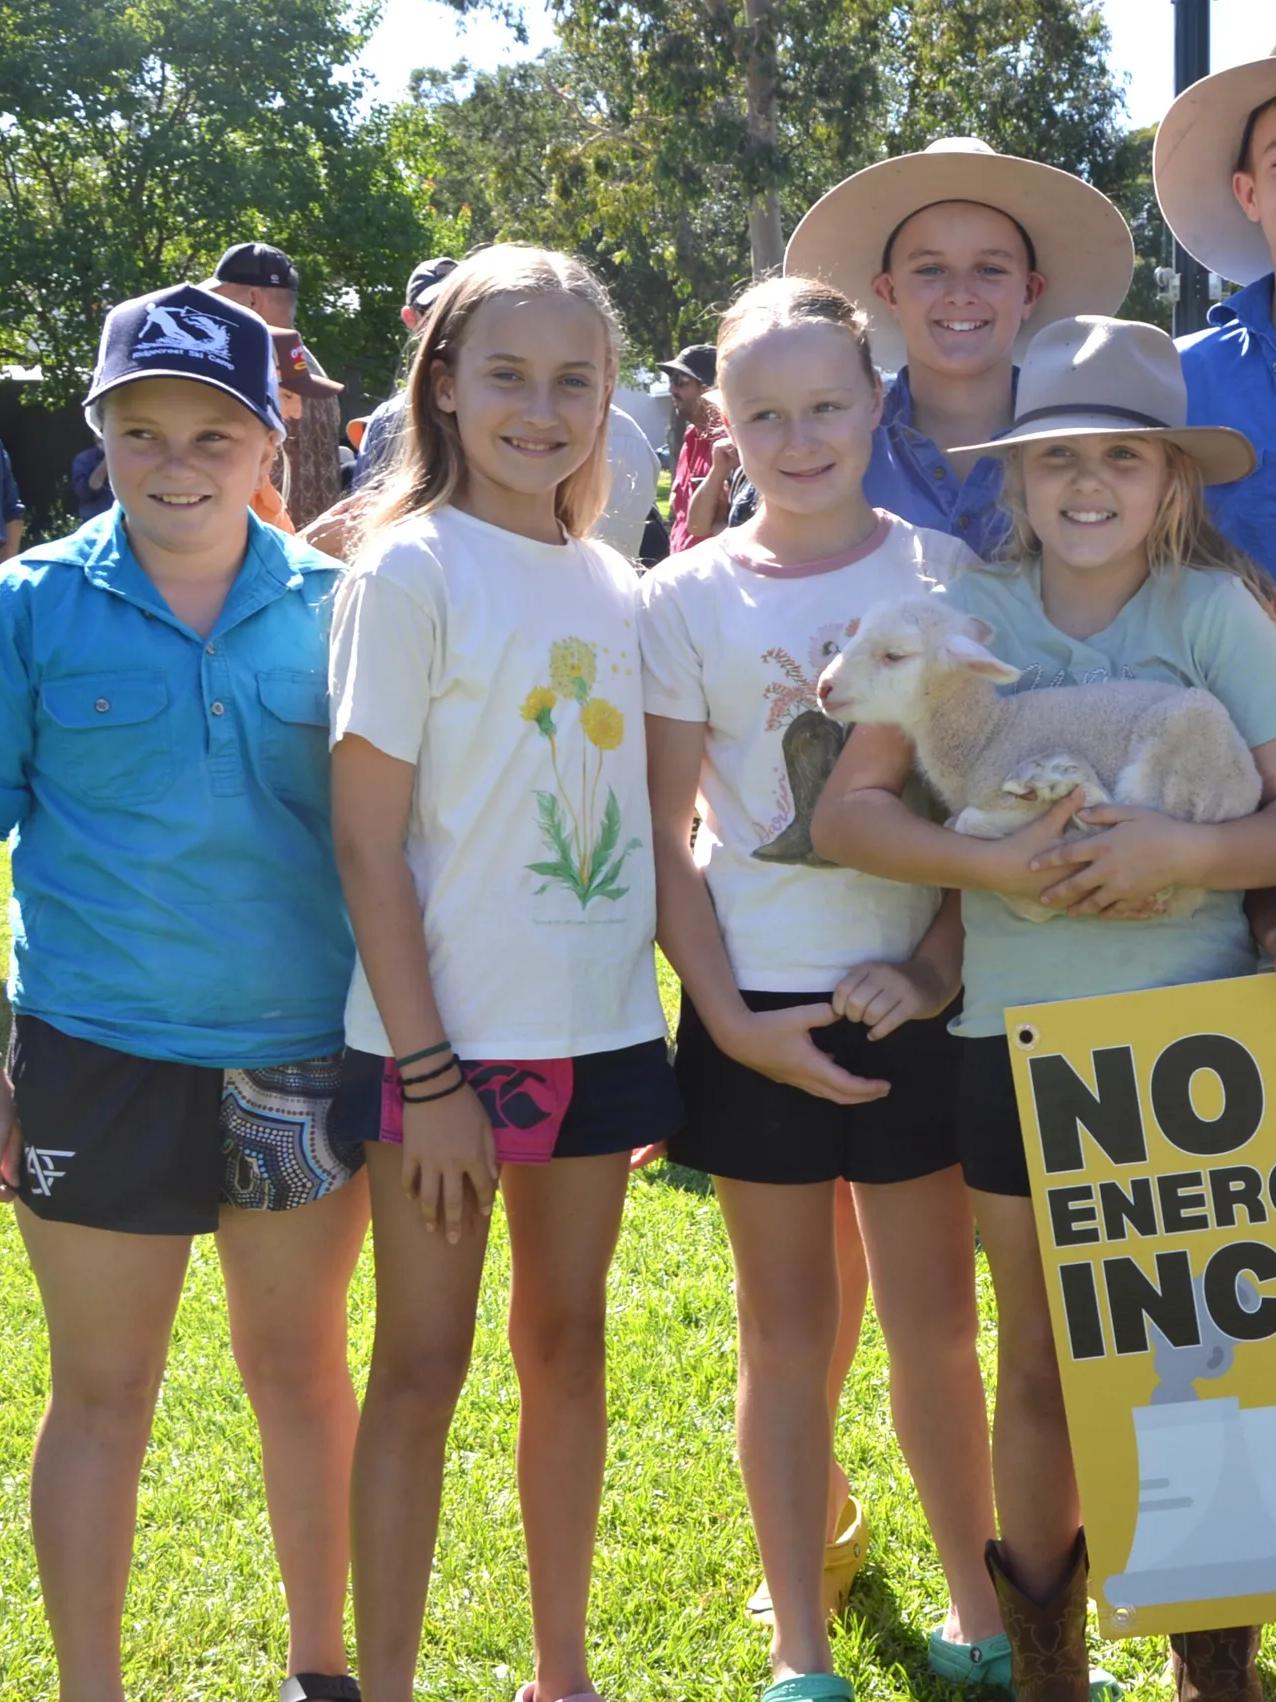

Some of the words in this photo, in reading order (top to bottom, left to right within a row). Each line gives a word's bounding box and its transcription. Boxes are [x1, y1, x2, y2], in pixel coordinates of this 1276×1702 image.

[188, 350, 204, 359] Ski
[208, 354, 235, 370] Camp
[1028, 1033, 1264, 1174] NO
